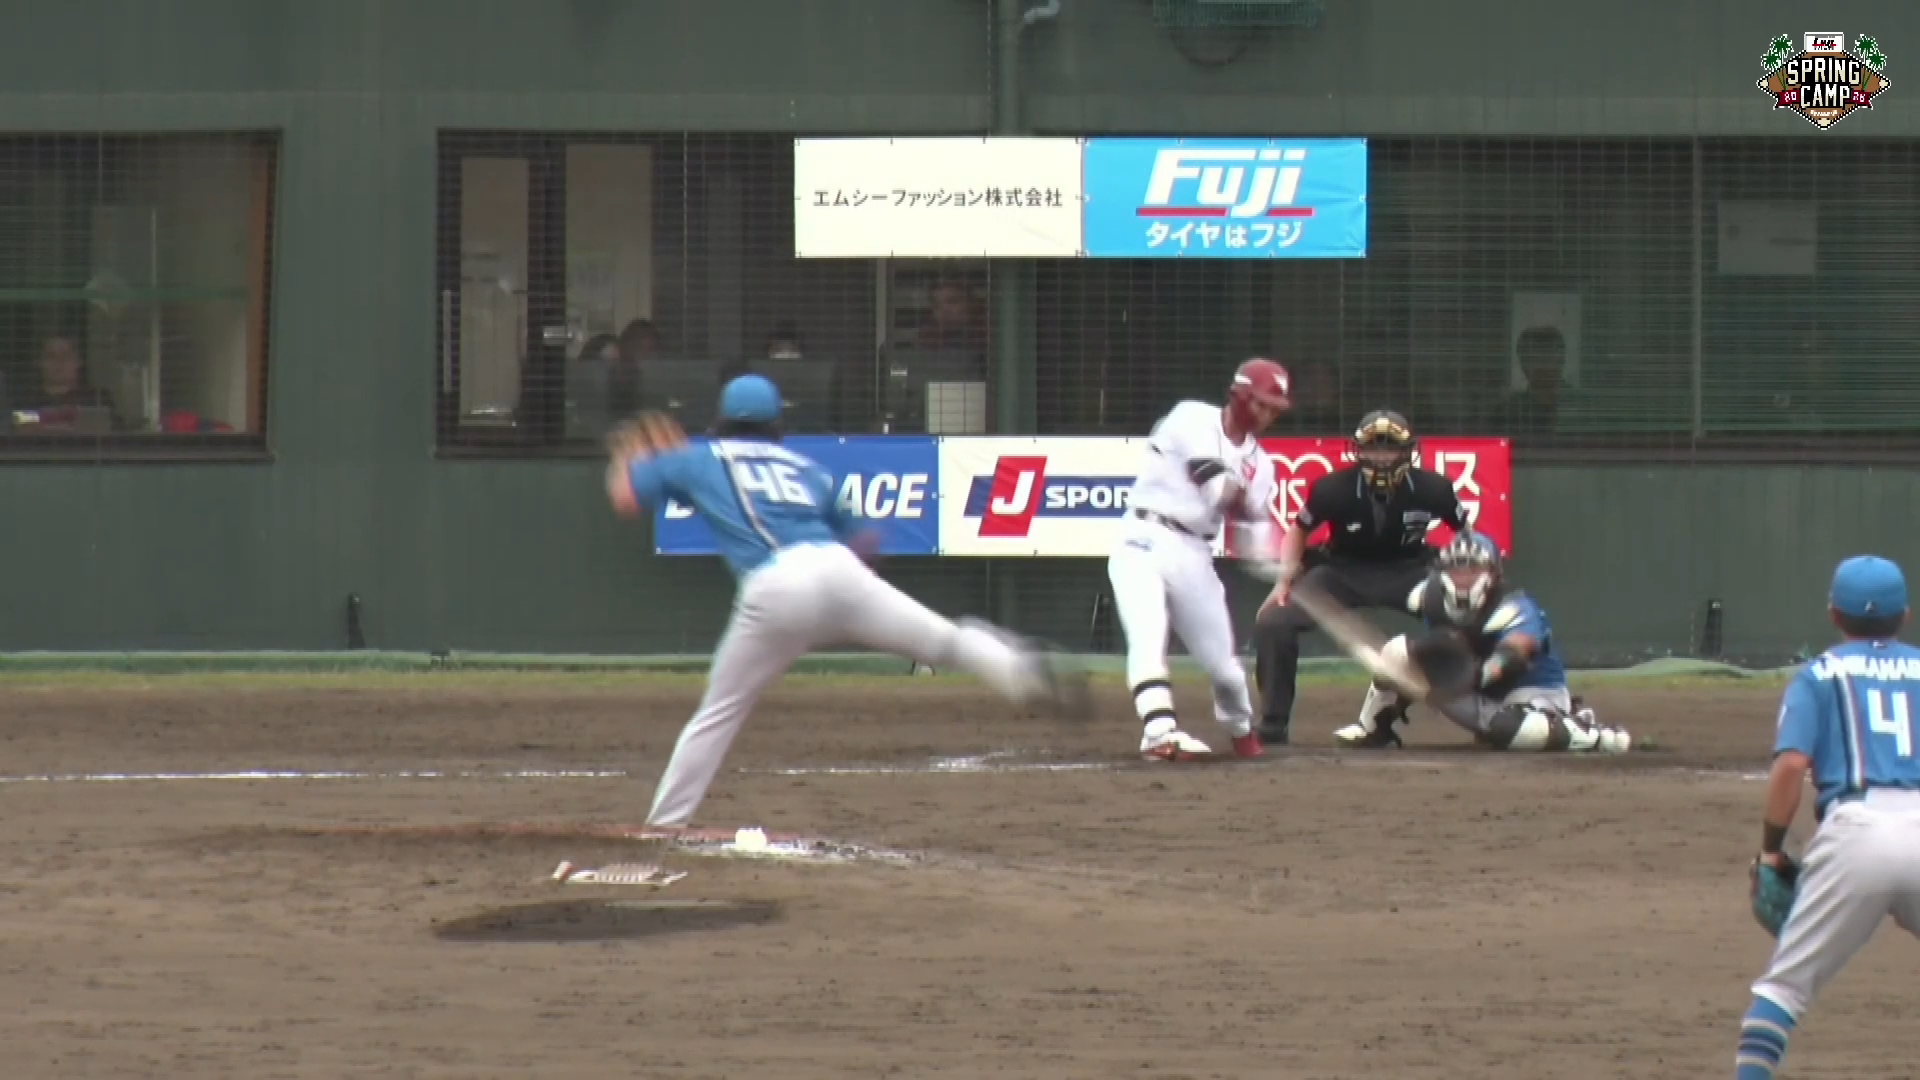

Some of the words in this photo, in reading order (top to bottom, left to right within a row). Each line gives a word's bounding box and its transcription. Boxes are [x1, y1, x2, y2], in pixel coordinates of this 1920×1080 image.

[813, 187, 1063, 207] エムシーファッション株式会社
[1144, 149, 1306, 217] Fuji
[1145, 222, 1302, 248] タイヤはフジ
[736, 461, 816, 506] 46
[991, 471, 1036, 515] J
[1867, 688, 1911, 757] 4
